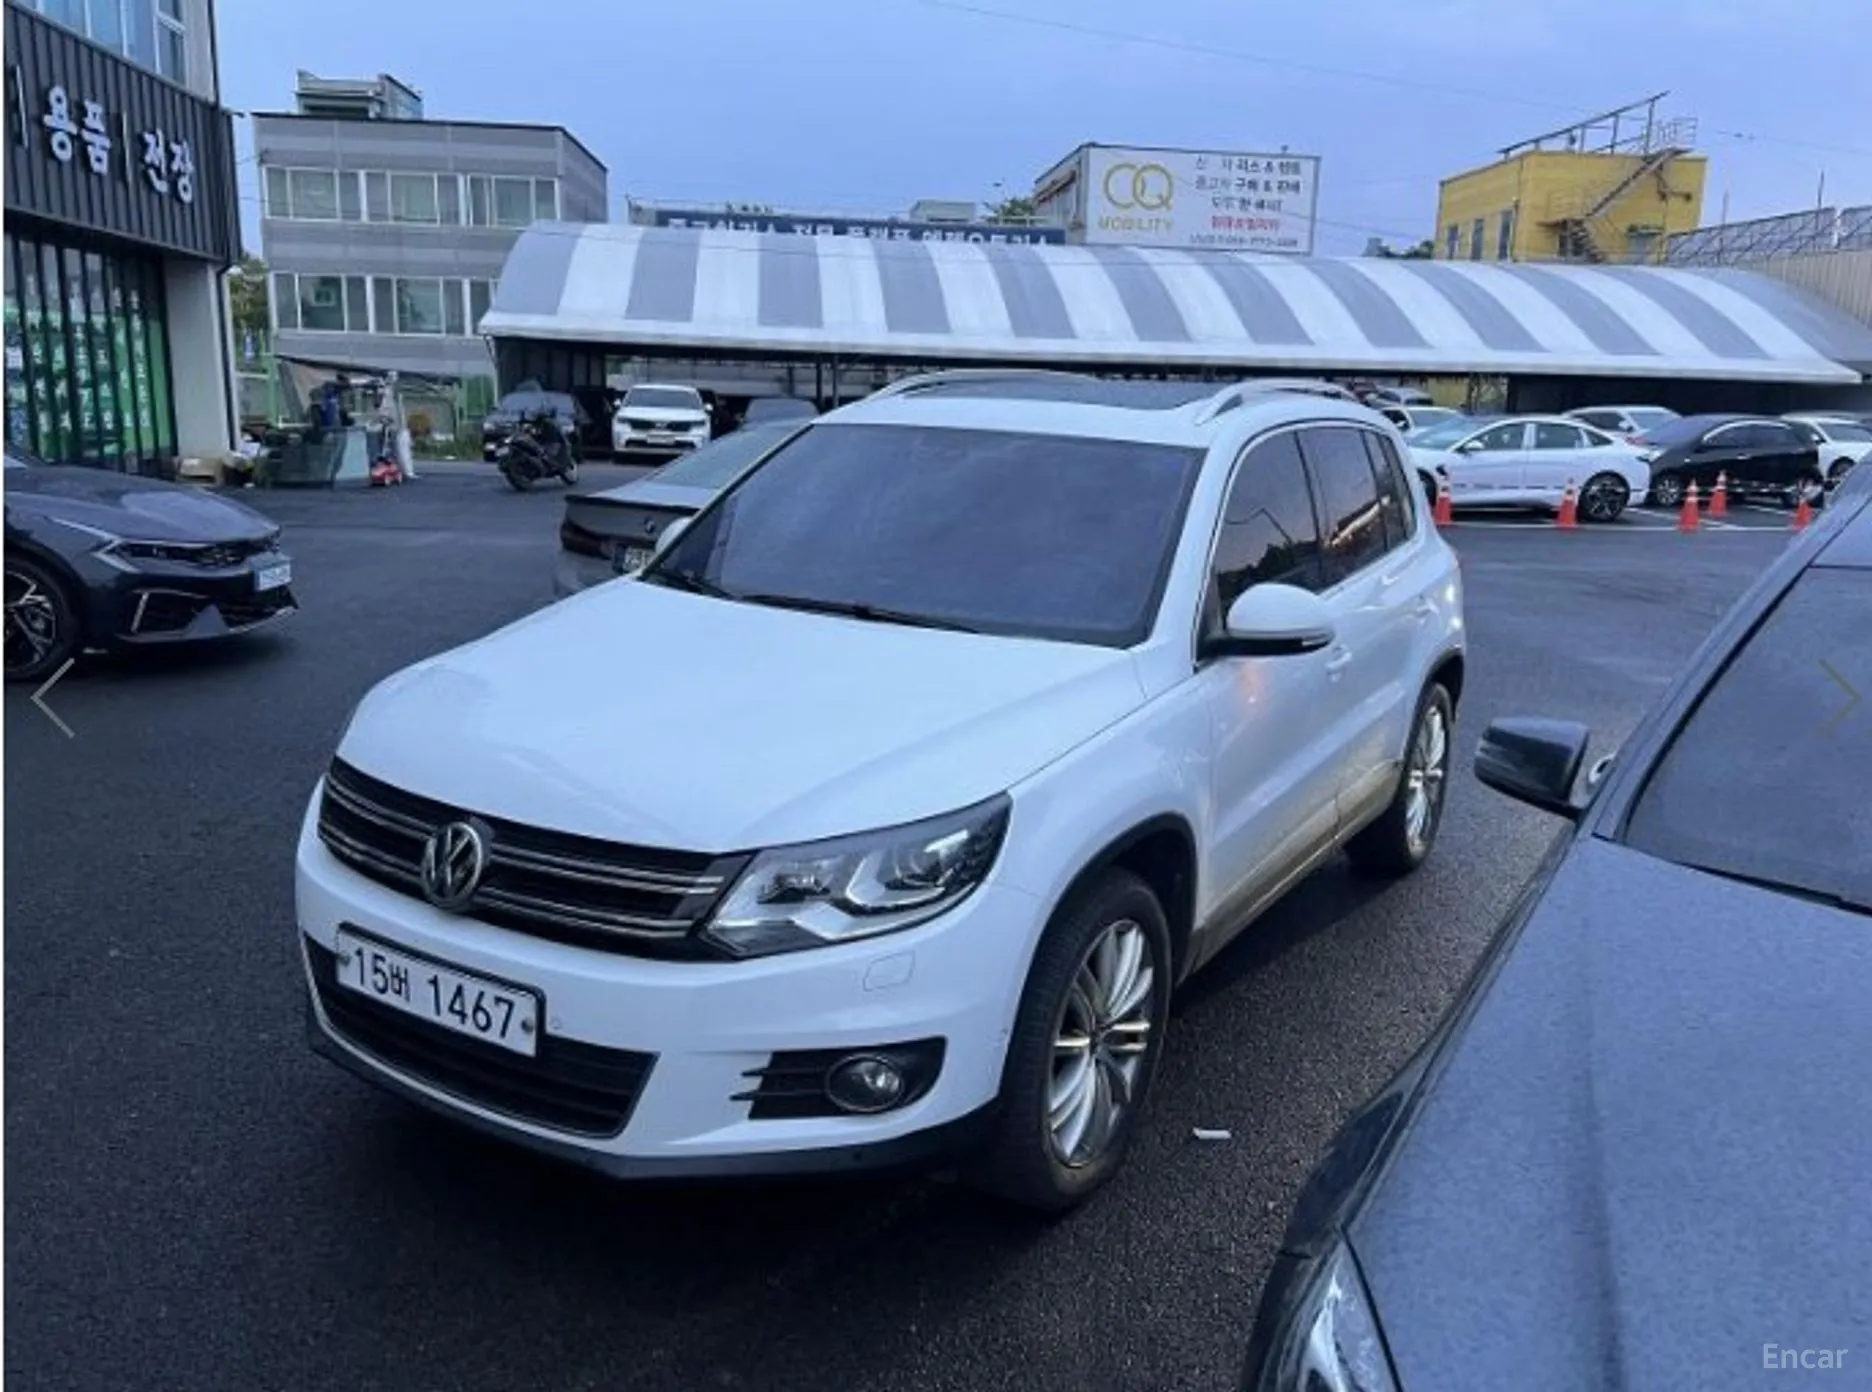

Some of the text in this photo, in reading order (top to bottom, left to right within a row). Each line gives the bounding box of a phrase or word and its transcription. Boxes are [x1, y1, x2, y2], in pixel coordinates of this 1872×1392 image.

[43, 86, 194, 204] 용품 전장
[356, 948, 514, 1039] 15버 1467
